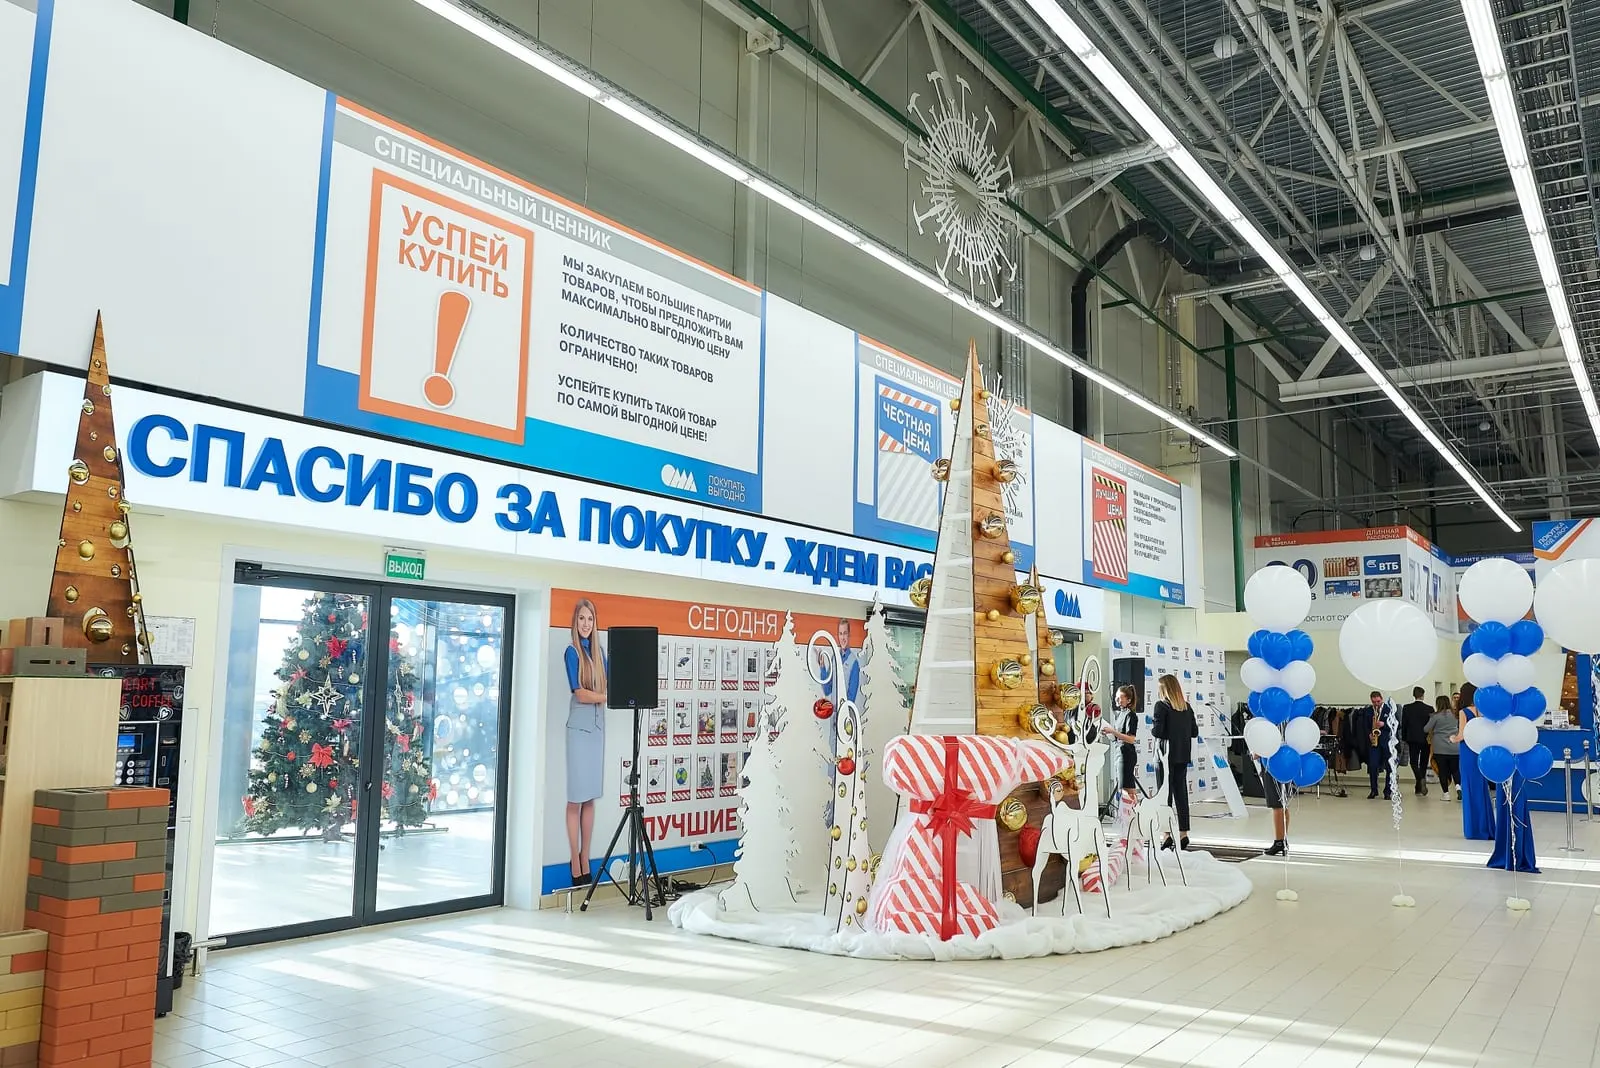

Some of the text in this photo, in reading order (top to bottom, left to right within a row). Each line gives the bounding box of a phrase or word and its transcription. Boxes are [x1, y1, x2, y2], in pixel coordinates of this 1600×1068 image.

[374, 135, 612, 250] СПЕЦИАЛЬНЫЙ ЦЕННИК
[401, 204, 508, 271] УСПЕЙ
[398, 238, 509, 298] КУПИТЬ
[561, 271, 744, 350] ТОВАРОВ, ЧТОБЫ ПРЕДЛОЖИТЬ ВАМ
[562, 255, 732, 331] МЫ ЗАКУПАЕМ БОЛЬШИЕ ПАРТИИ
[561, 289, 731, 360] МАКСИМАЛЬНО ВЫГОДНУЮ ЦЕНУ
[559, 339, 638, 374] ОГРАНИЧЕНО!
[560, 322, 714, 384] КОЛИЧЕСТВО ТАКИХ ТОВАРОВ
[875, 354, 941, 392] СПЕЦИАЛЬНЫЙ
[557, 373, 717, 430] УСПЕЙТЕ КУПИТЬ ТАКОЙ ТОВАР
[557, 391, 708, 443] ПО САМОЙ ВЫГОДНОЙ ЦЕНЕ!
[882, 401, 931, 438] ЧЕСТНАЯ
[903, 428, 931, 455] ЦЕНА
[127, 413, 479, 524] СПАСИБО
[495, 483, 566, 539] ЗА
[578, 497, 775, 570] ПОКУПКУ.
[784, 537, 880, 588] ЖДЕМ
[707, 486, 746, 503] ВЫГОДНО
[708, 474, 746, 492] ПОКУПАТЬ
[1095, 488, 1119, 502] ЛУЧШАЯ
[1107, 503, 1123, 517] ЦЕНА
[1366, 528, 1400, 537] ДЛИННАЯ
[387, 561, 424, 579] ВЫХОД
[1378, 561, 1400, 571] ВТБ
[688, 605, 778, 638] СЕГОДНЯ
[1303, 615, 1326, 623] ОСТИ
[1326, 614, 1336, 622] ОТ
[122, 677, 157, 691] EART
[641, 808, 738, 842] ЛУЧШИЕ
